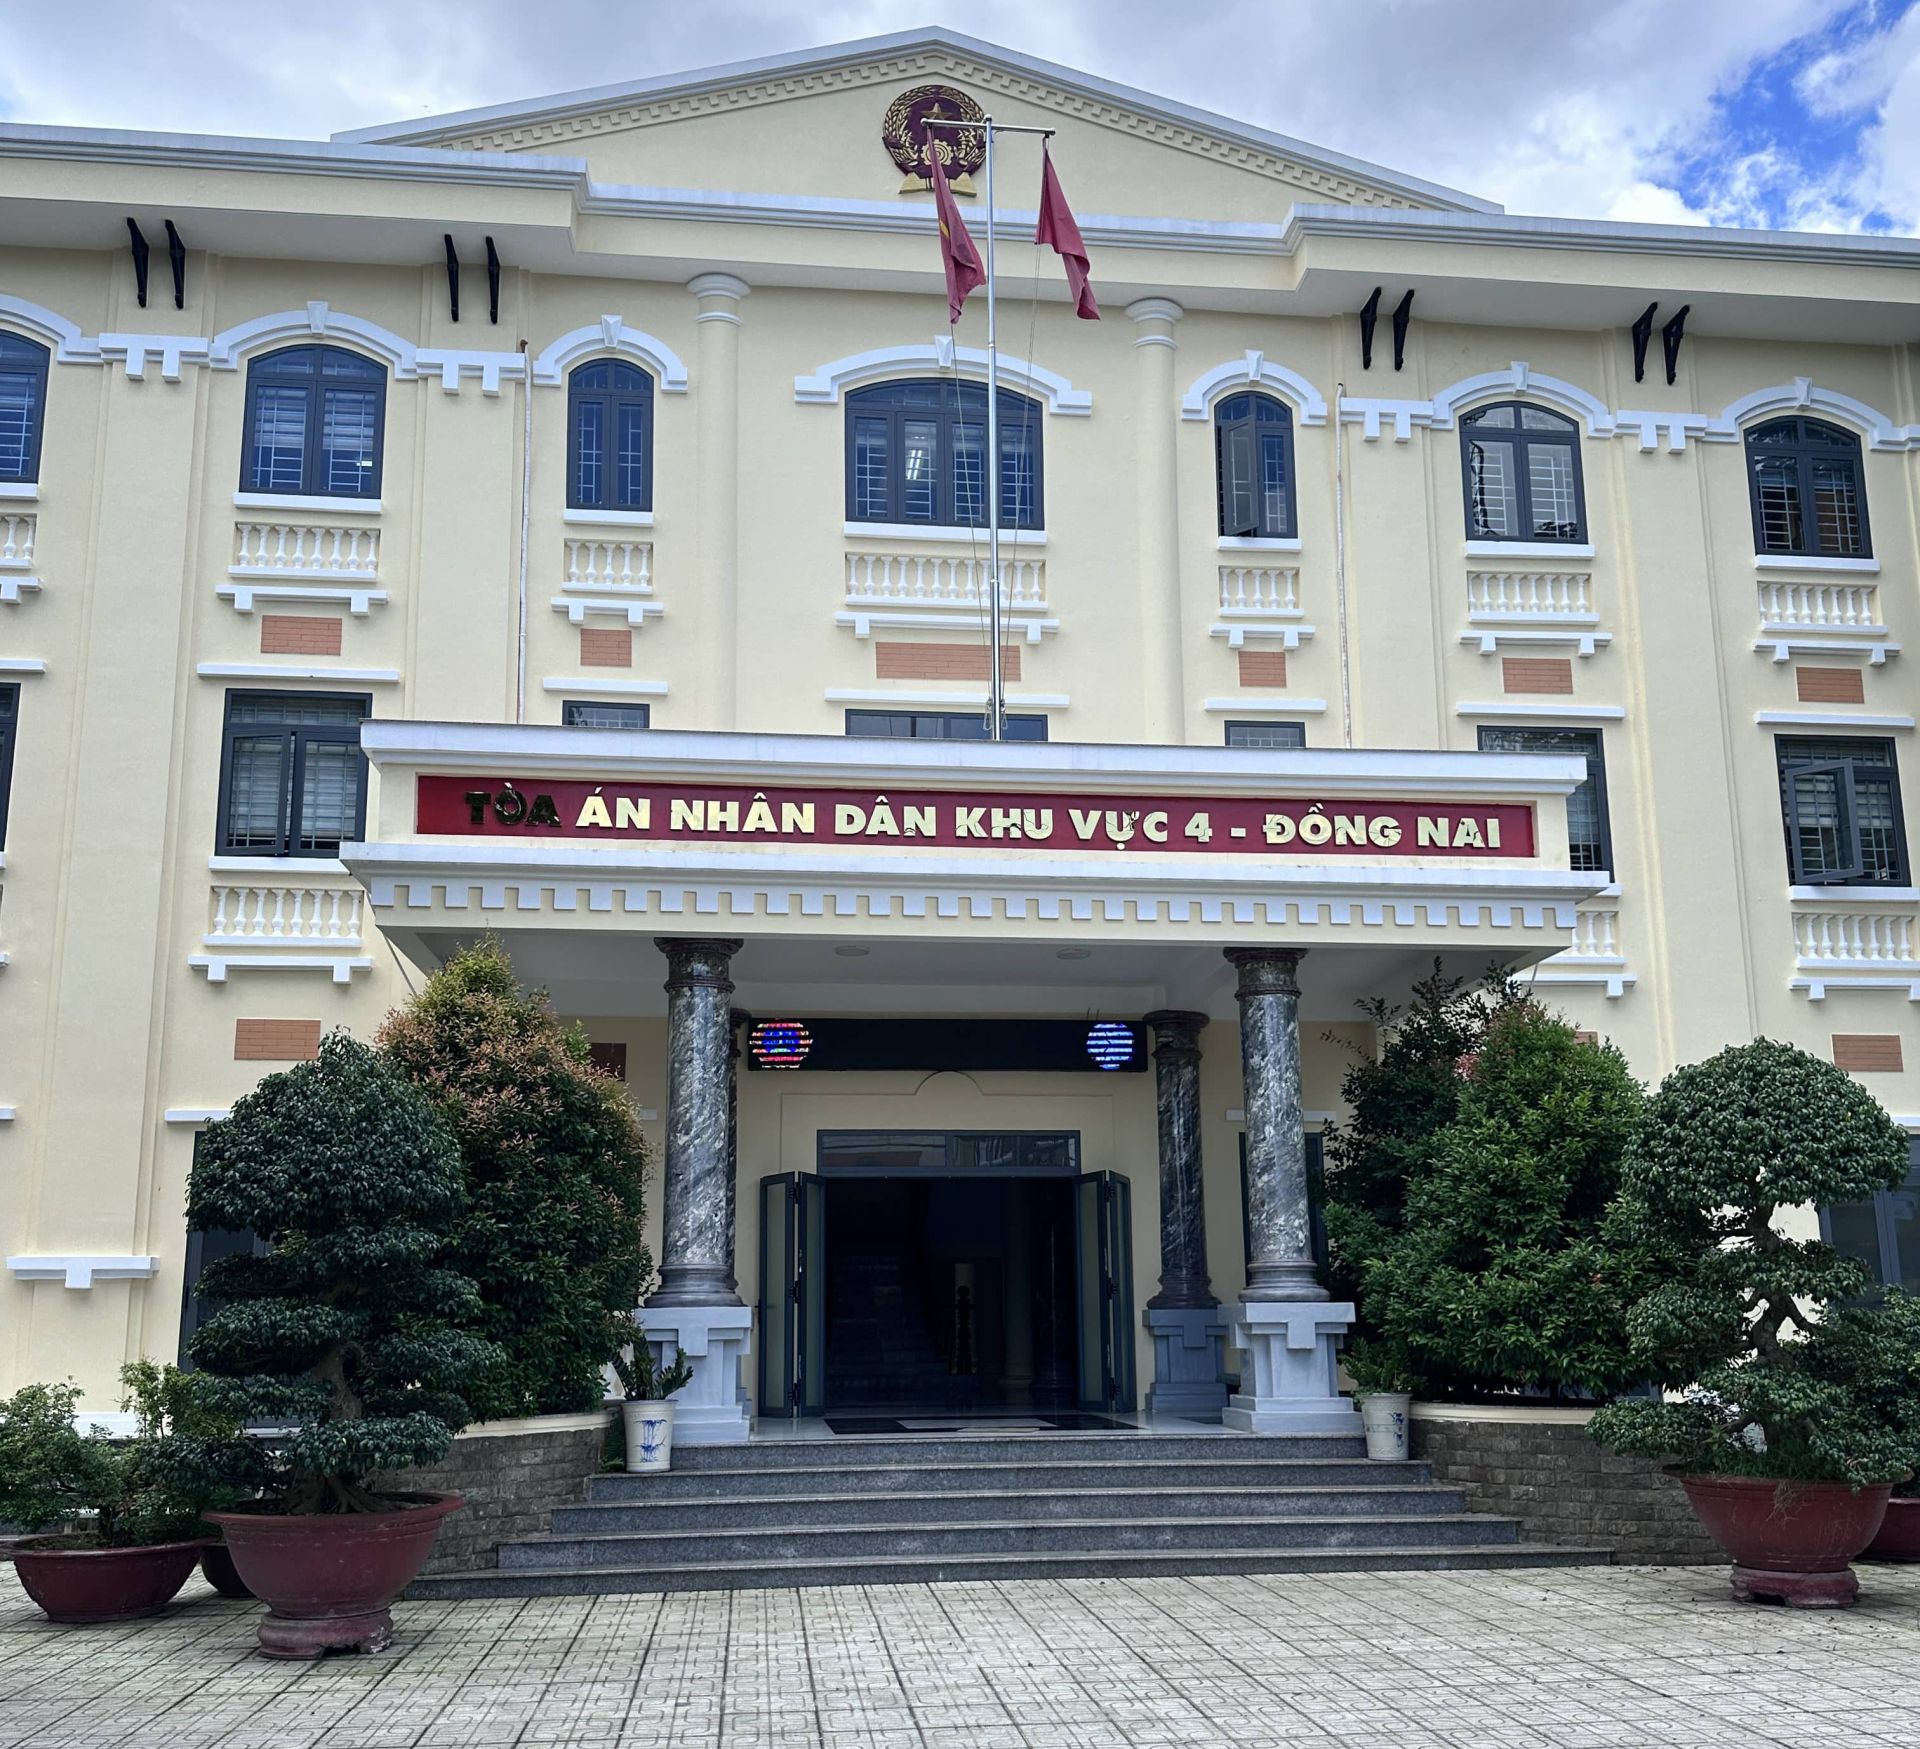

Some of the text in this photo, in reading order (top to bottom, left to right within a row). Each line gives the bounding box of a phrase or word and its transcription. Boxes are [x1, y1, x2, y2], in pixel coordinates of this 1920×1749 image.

[465, 782, 1501, 850] TÒA ÁN NHÂN DÂN KHU VỰC 4 - ĐỒNG NAI
